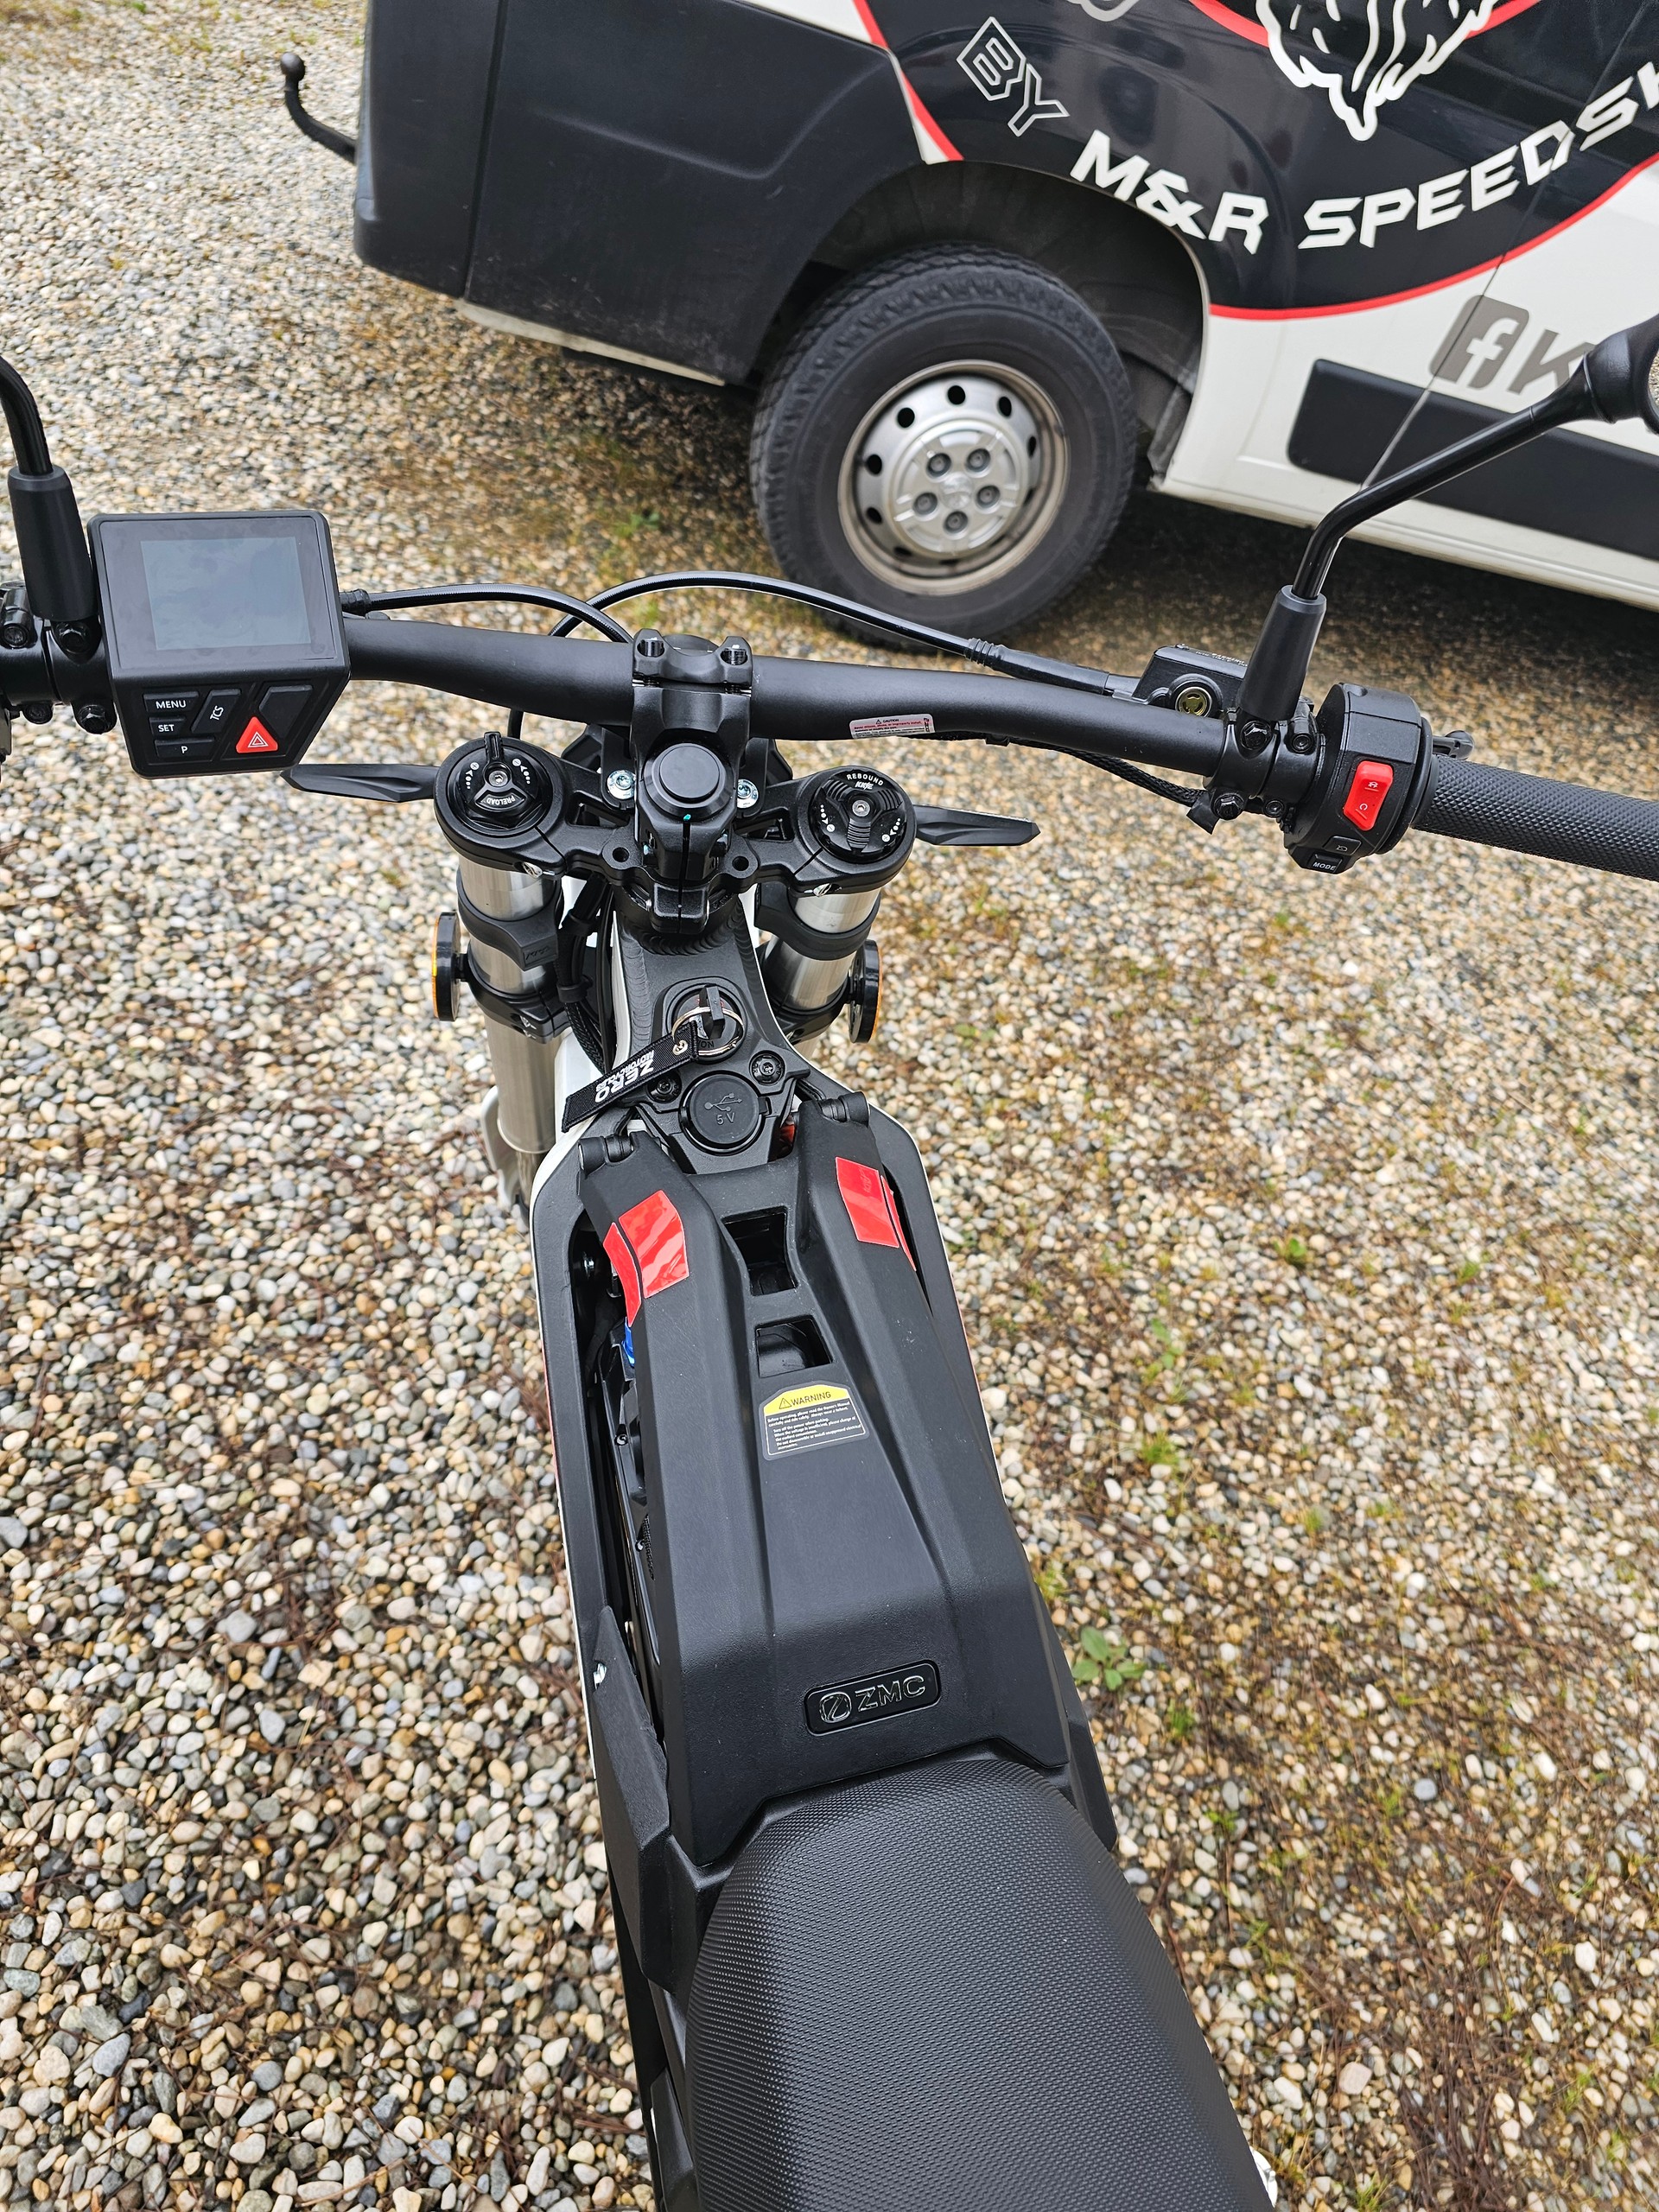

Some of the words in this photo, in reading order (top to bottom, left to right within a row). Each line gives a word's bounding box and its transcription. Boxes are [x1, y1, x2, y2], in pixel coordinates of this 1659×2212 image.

[957, 16, 1071, 137] BY
[1070, 130, 1270, 254] M&R
[156, 699, 187, 709] MENU
[209, 705, 224, 721] TCS
[158, 724, 175, 733] SET
[181, 746, 188, 754] P
[847, 772, 884, 786] REBOUND
[486, 795, 516, 806] PRELOAD
[1313, 861, 1337, 871] MODE
[700, 1039, 715, 1048] ON
[596, 1050, 654, 1092] MOTORCYCLES
[595, 1058, 654, 1103] ZERO
[791, 1391, 831, 1407] WARNING
[855, 1675, 926, 1712] ZMC
